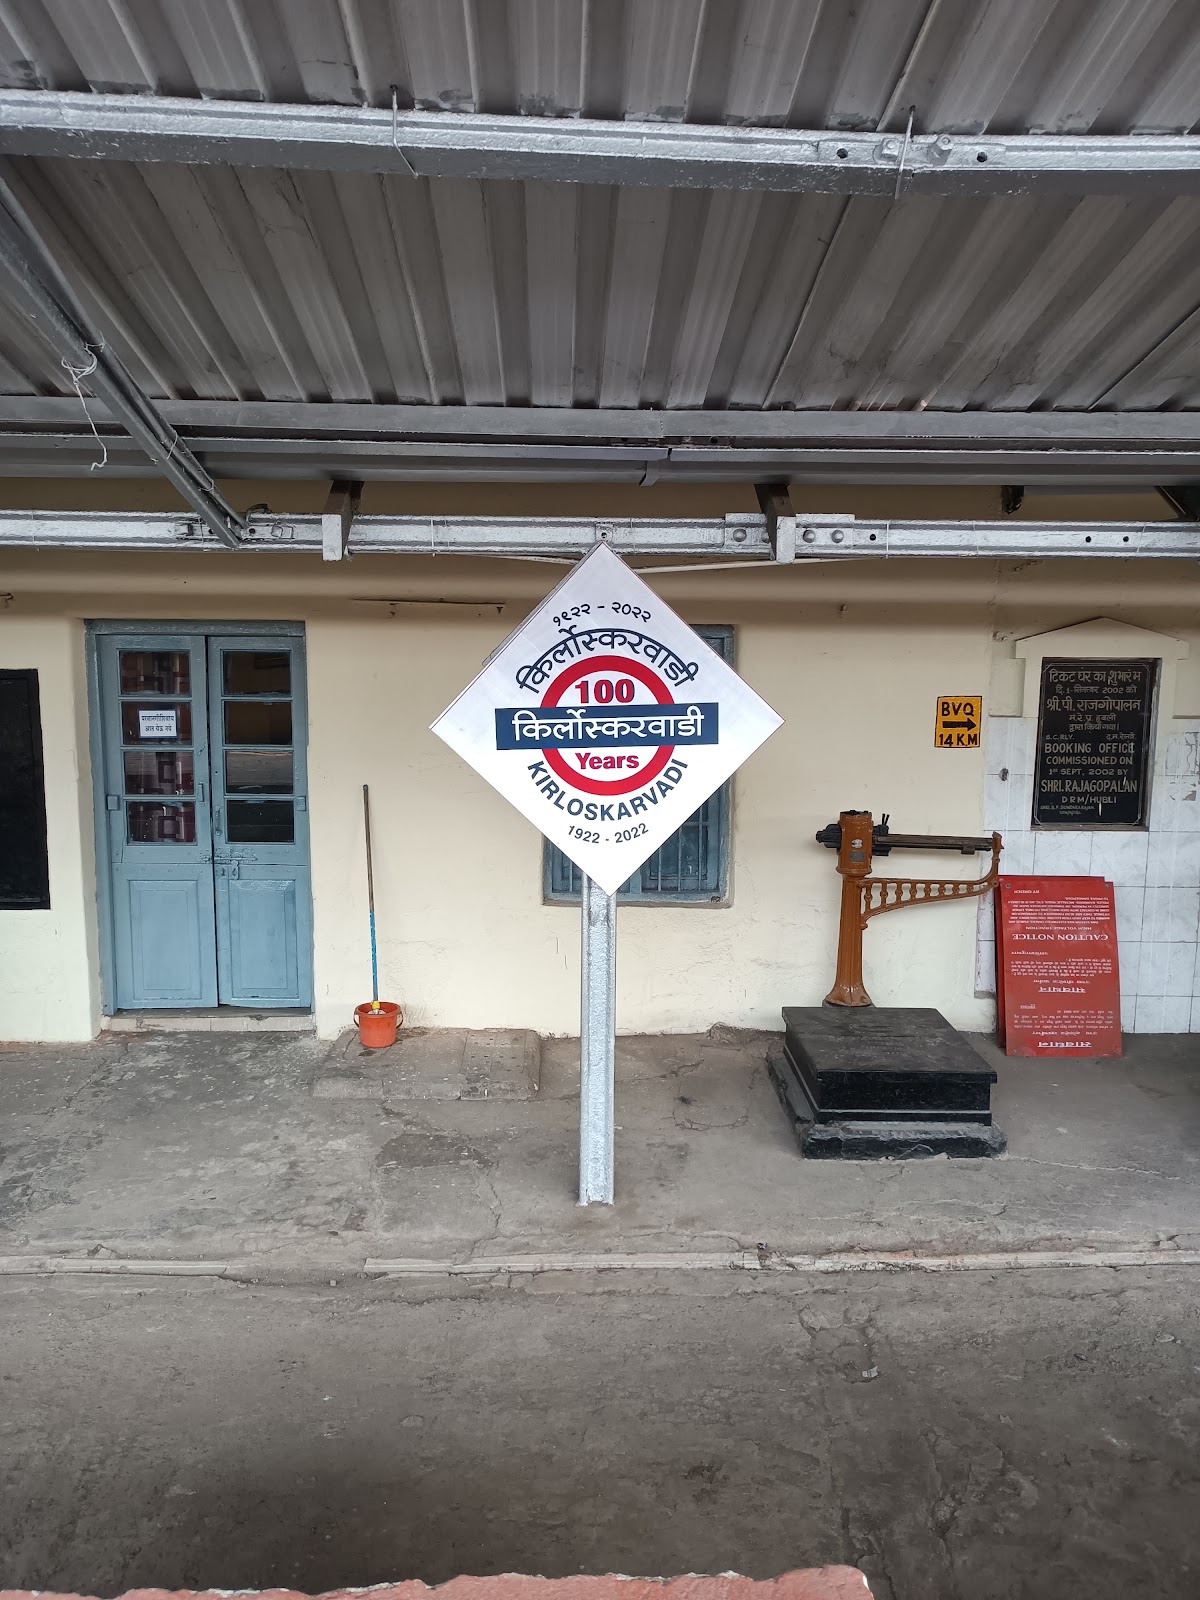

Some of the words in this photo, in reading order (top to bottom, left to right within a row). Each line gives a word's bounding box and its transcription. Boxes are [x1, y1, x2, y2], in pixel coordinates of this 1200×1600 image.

[553, 604, 590, 626] १९२२
[612, 602, 652, 622] २०२२
[516, 625, 699, 693] किर्लोस्करवाडी
[1049, 668, 1076, 682] टिकट
[1093, 671, 1106, 682] का
[575, 679, 635, 704] 100
[942, 702, 974, 716] BVQ
[1077, 696, 1141, 711] राजगोपालन
[512, 706, 704, 741] किर्लोस्करवाडी
[939, 734, 953, 746] 14
[1045, 743, 1092, 753] BOOKING
[1099, 743, 1135, 753] OFFICE
[575, 752, 639, 770] Years
[1046, 756, 1117, 764] COMMISSIONED
[1120, 756, 1133, 764] ON
[528, 758, 688, 821] KIRLOSKARVADI
[568, 825, 600, 844] 1922
[615, 822, 648, 843] 2022
